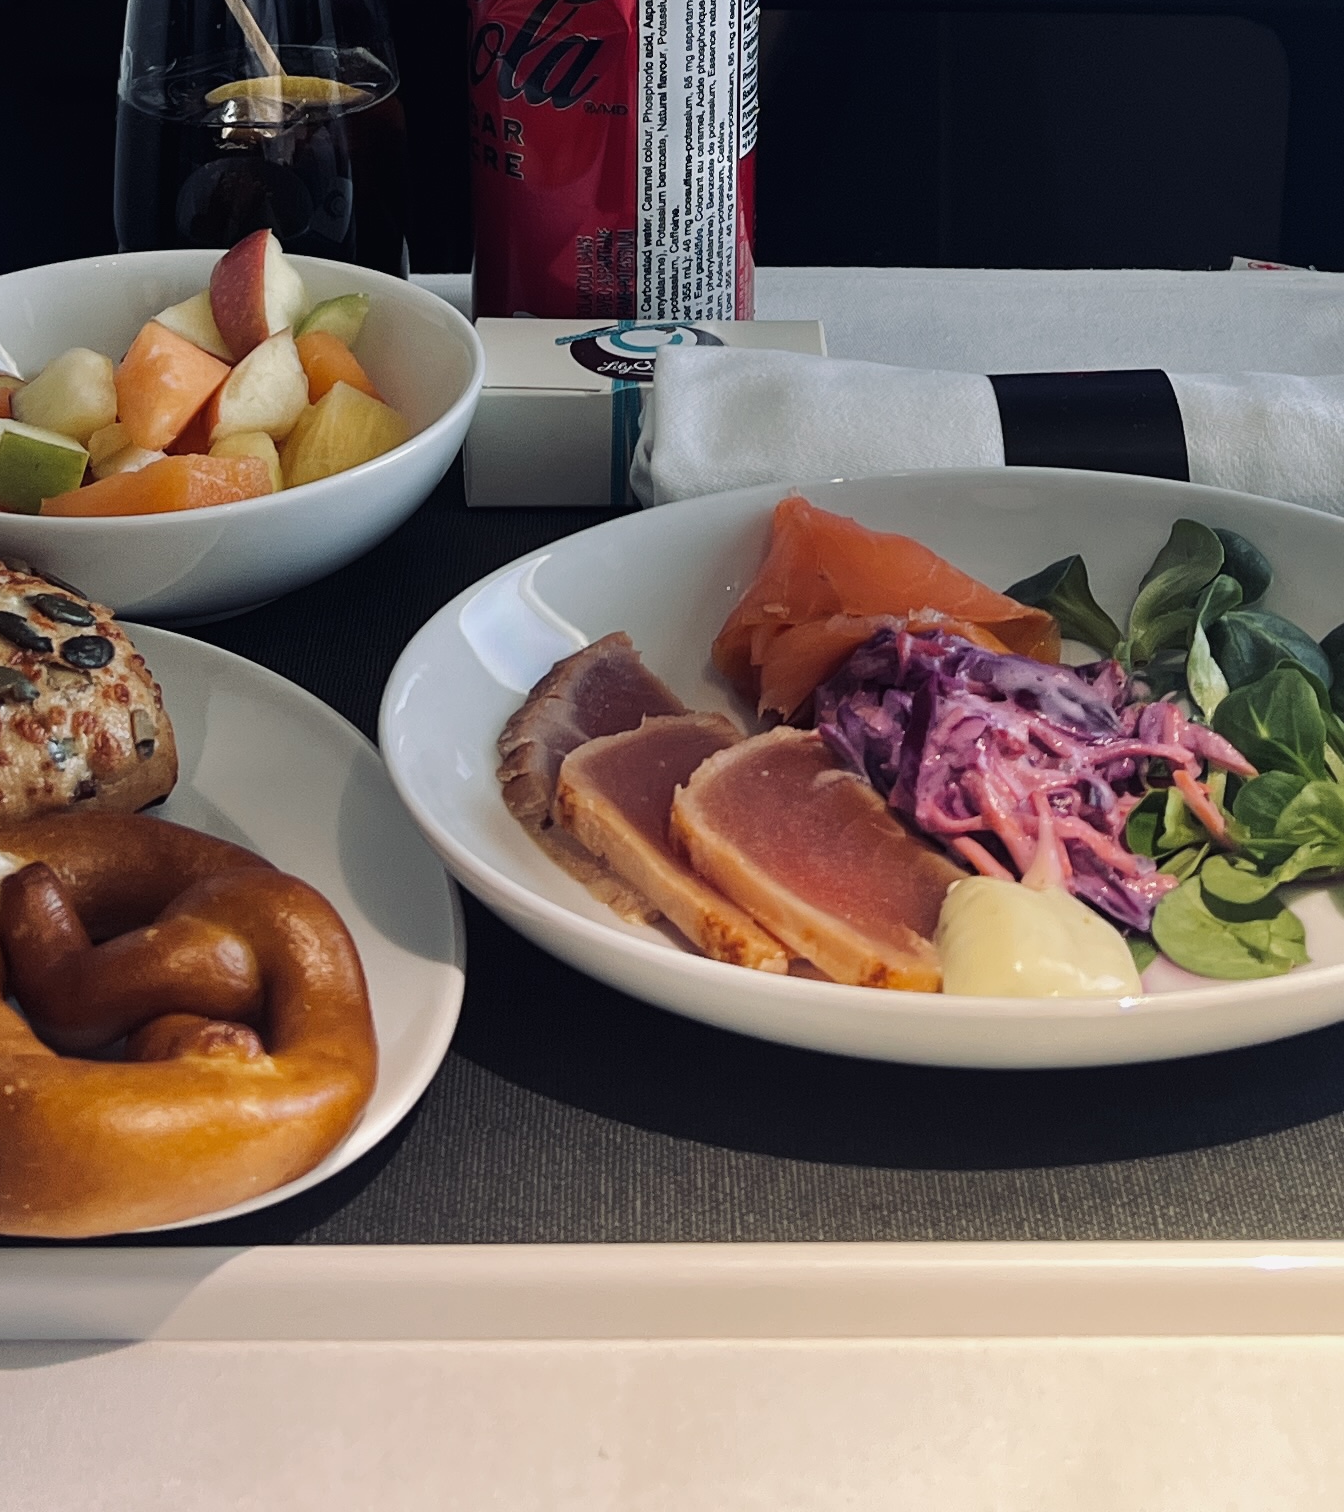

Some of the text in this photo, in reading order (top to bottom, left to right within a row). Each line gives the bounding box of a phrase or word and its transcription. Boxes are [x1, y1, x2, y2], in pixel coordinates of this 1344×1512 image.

[643, 62, 655, 123] Phosphoric
[657, 92, 667, 131] Natural
[643, 127, 654, 162] colour,
[642, 166, 652, 211] Caramel
[656, 191, 666, 247] Potassium
[641, 250, 651, 312] Carbonated
[683, 282, 691, 302] 355
